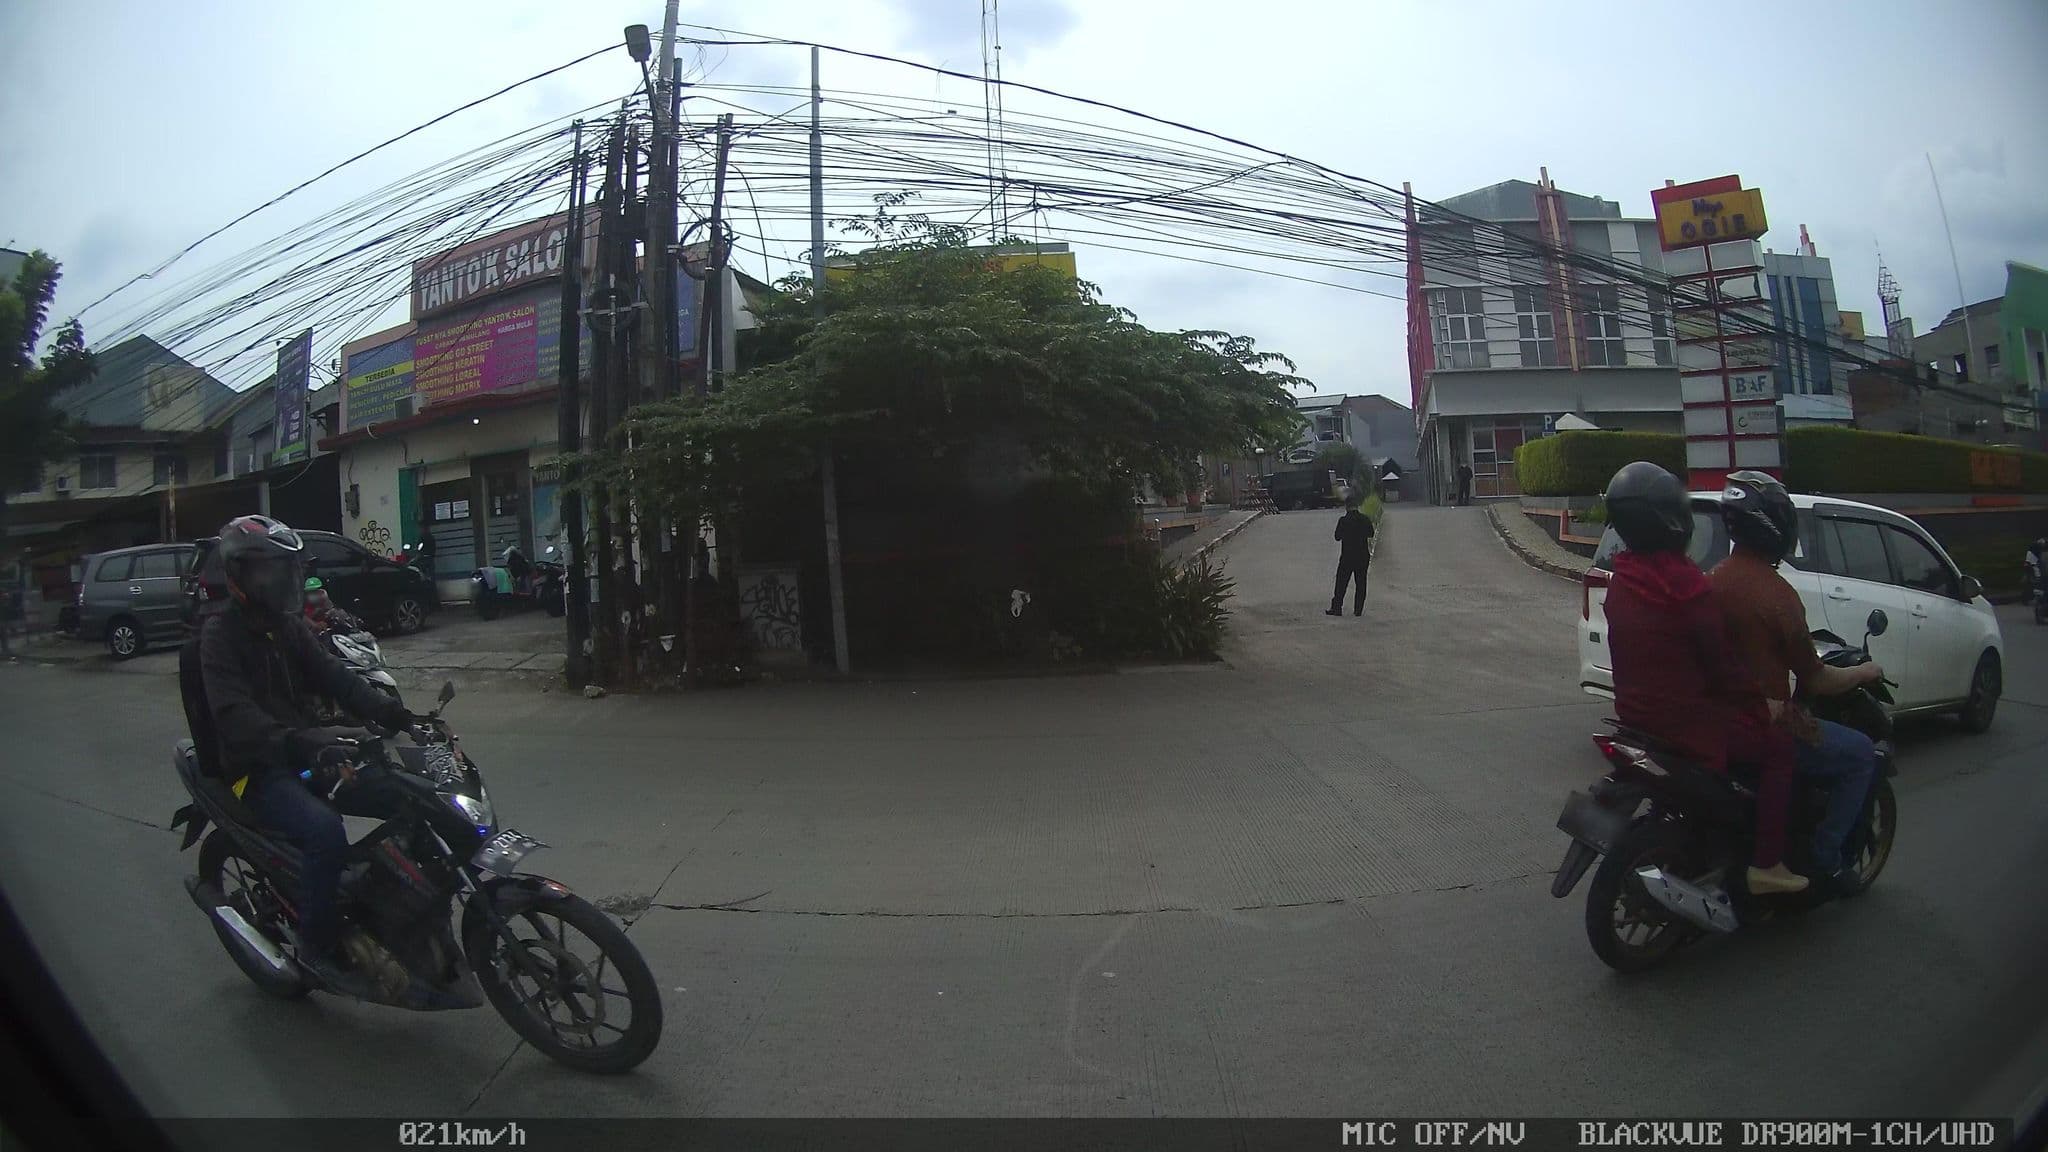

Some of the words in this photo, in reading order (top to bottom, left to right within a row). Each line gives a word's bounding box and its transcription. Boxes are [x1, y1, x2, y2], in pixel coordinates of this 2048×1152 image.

[420, 249, 500, 311] YANTO'K
[512, 305, 535, 319] SALON
[467, 339, 494, 355] STREET
[365, 368, 395, 383] TERSEDIA
[455, 380, 481, 395] MATRIX
[1544, 415, 1552, 430] P
